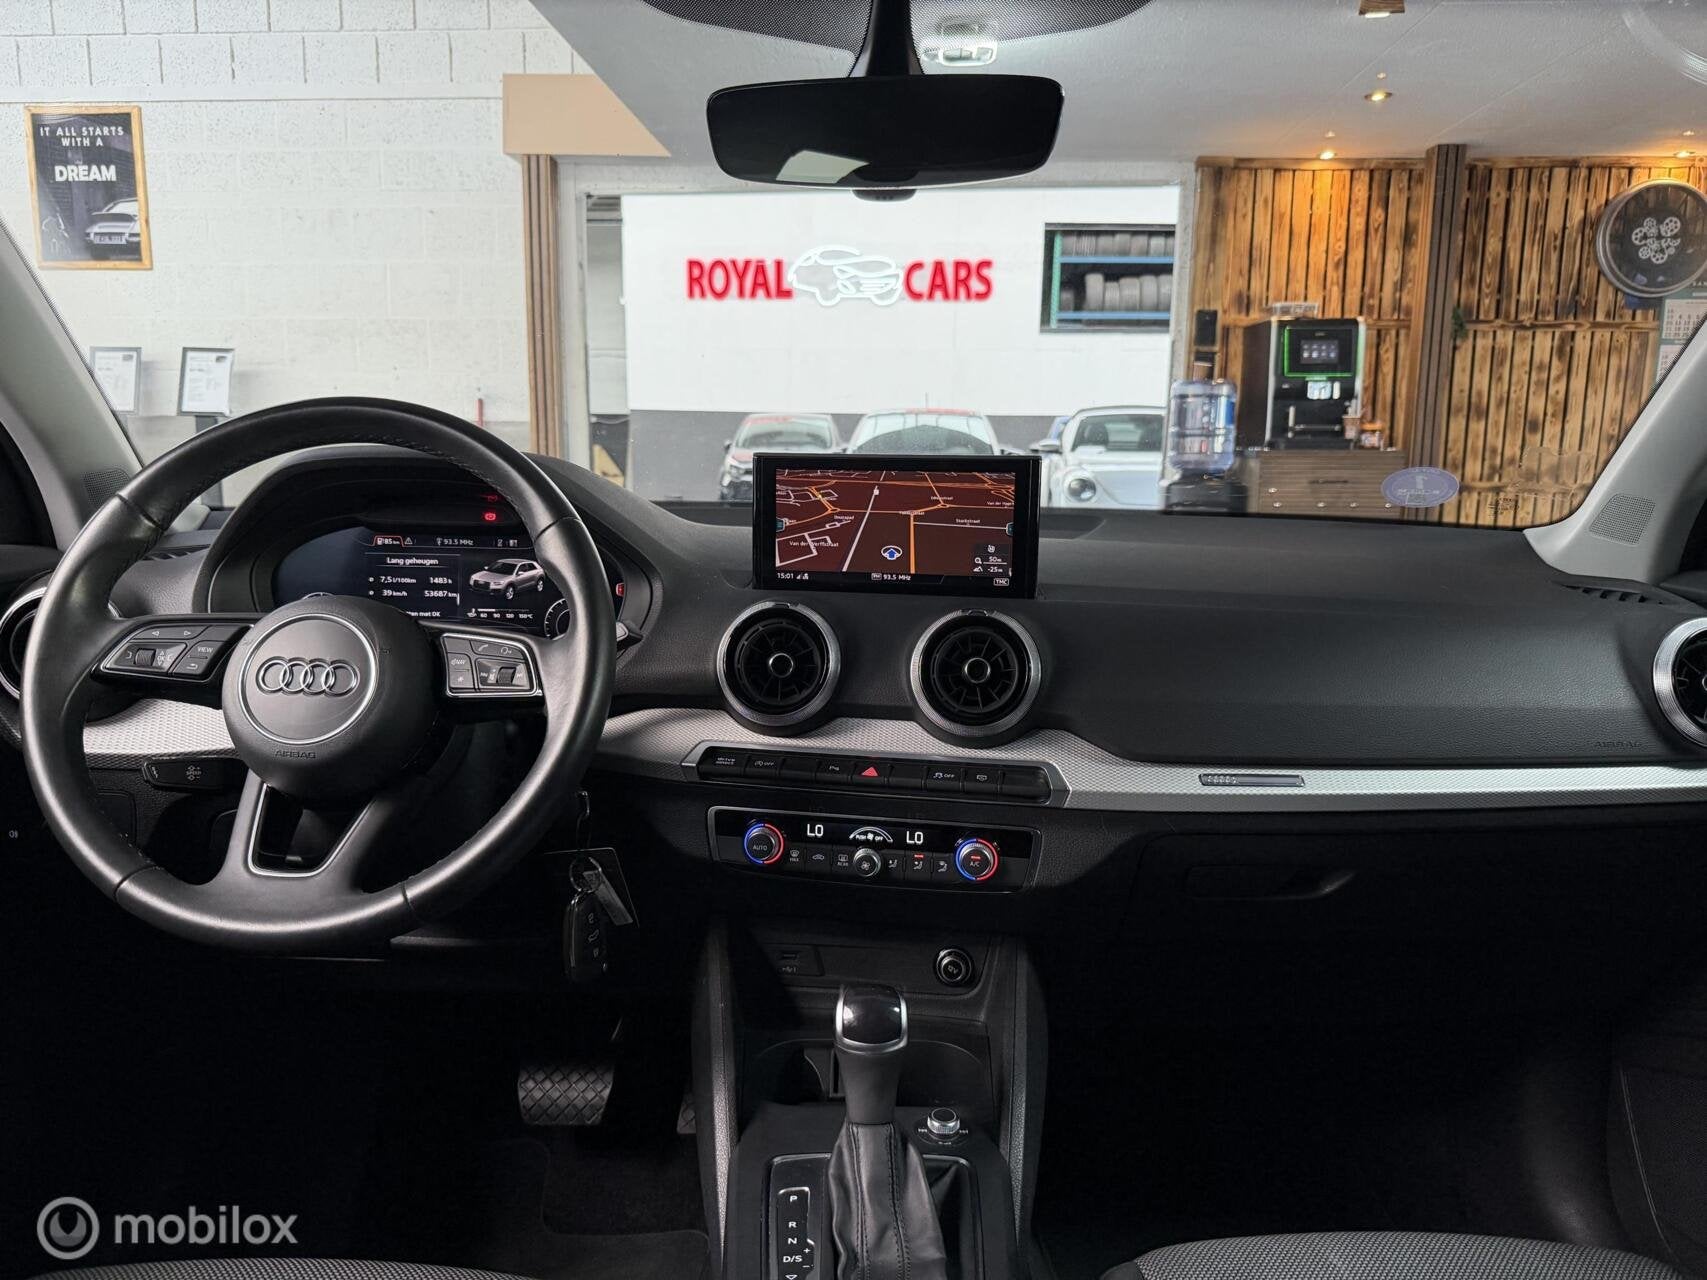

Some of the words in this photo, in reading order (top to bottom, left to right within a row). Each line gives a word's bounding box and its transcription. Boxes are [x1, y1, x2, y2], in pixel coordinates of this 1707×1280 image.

[40, 126, 50, 136] IT
[56, 126, 77, 136] ALL
[82, 126, 124, 136] STARTS
[61, 137, 90, 147] WITH
[96, 137, 104, 147] A
[54, 164, 117, 182] DREAM
[686, 258, 793, 299] ROYAL
[905, 260, 994, 301] CARS
[387, 557, 403, 566] Lang
[405, 557, 438, 567] geheugen
[777, 572, 793, 580] 15:01
[383, 589, 392, 597] 39
[425, 590, 447, 598] 53687
[275, 750, 317, 759] AIRBAG
[806, 823, 824, 837] LO
[906, 831, 924, 844] LO
[788, 1221, 797, 1229] R
[787, 1237, 798, 1245] N
[782, 1254, 803, 1263] D/S
